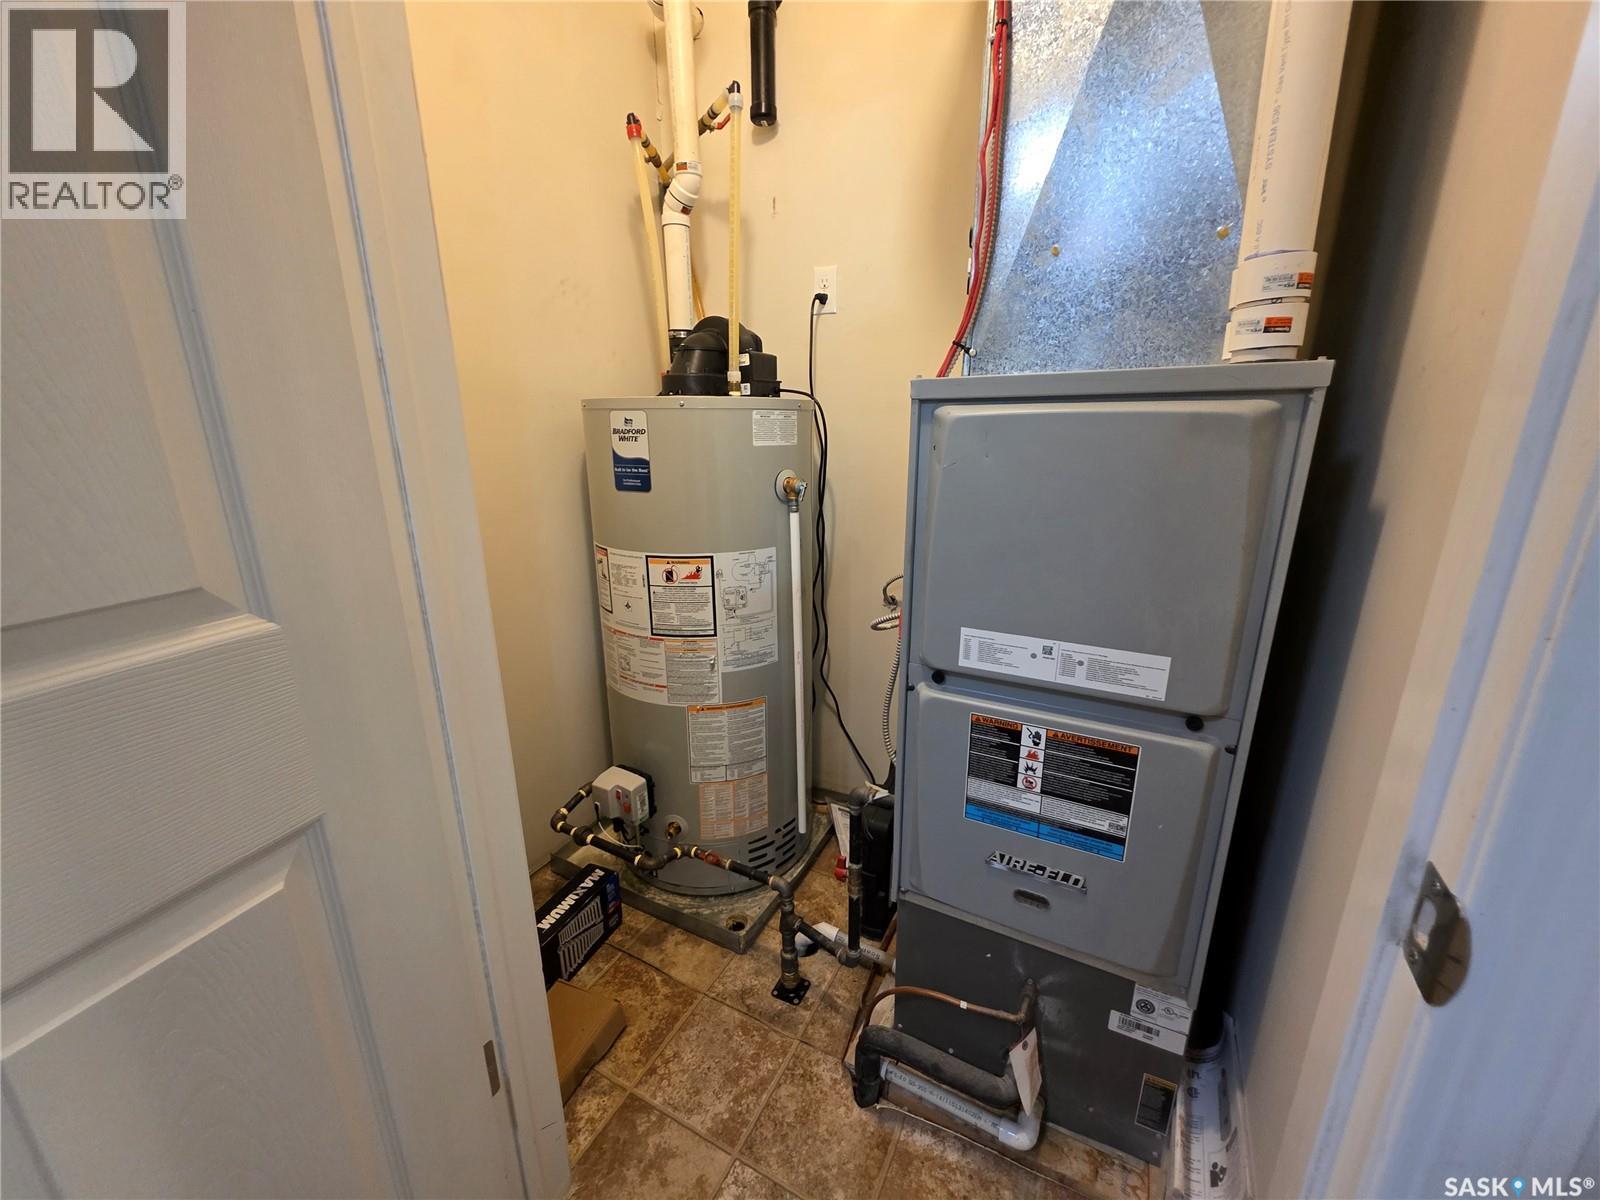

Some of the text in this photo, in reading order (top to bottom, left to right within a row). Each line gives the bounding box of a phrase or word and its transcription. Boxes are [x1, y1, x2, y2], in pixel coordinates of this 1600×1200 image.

[612, 427, 646, 435] BRADFORD
[982, 716, 1019, 730] WARNING
[1060, 733, 1133, 754] AVERTISSEMENT
[536, 868, 605, 931] MAXIMUM
